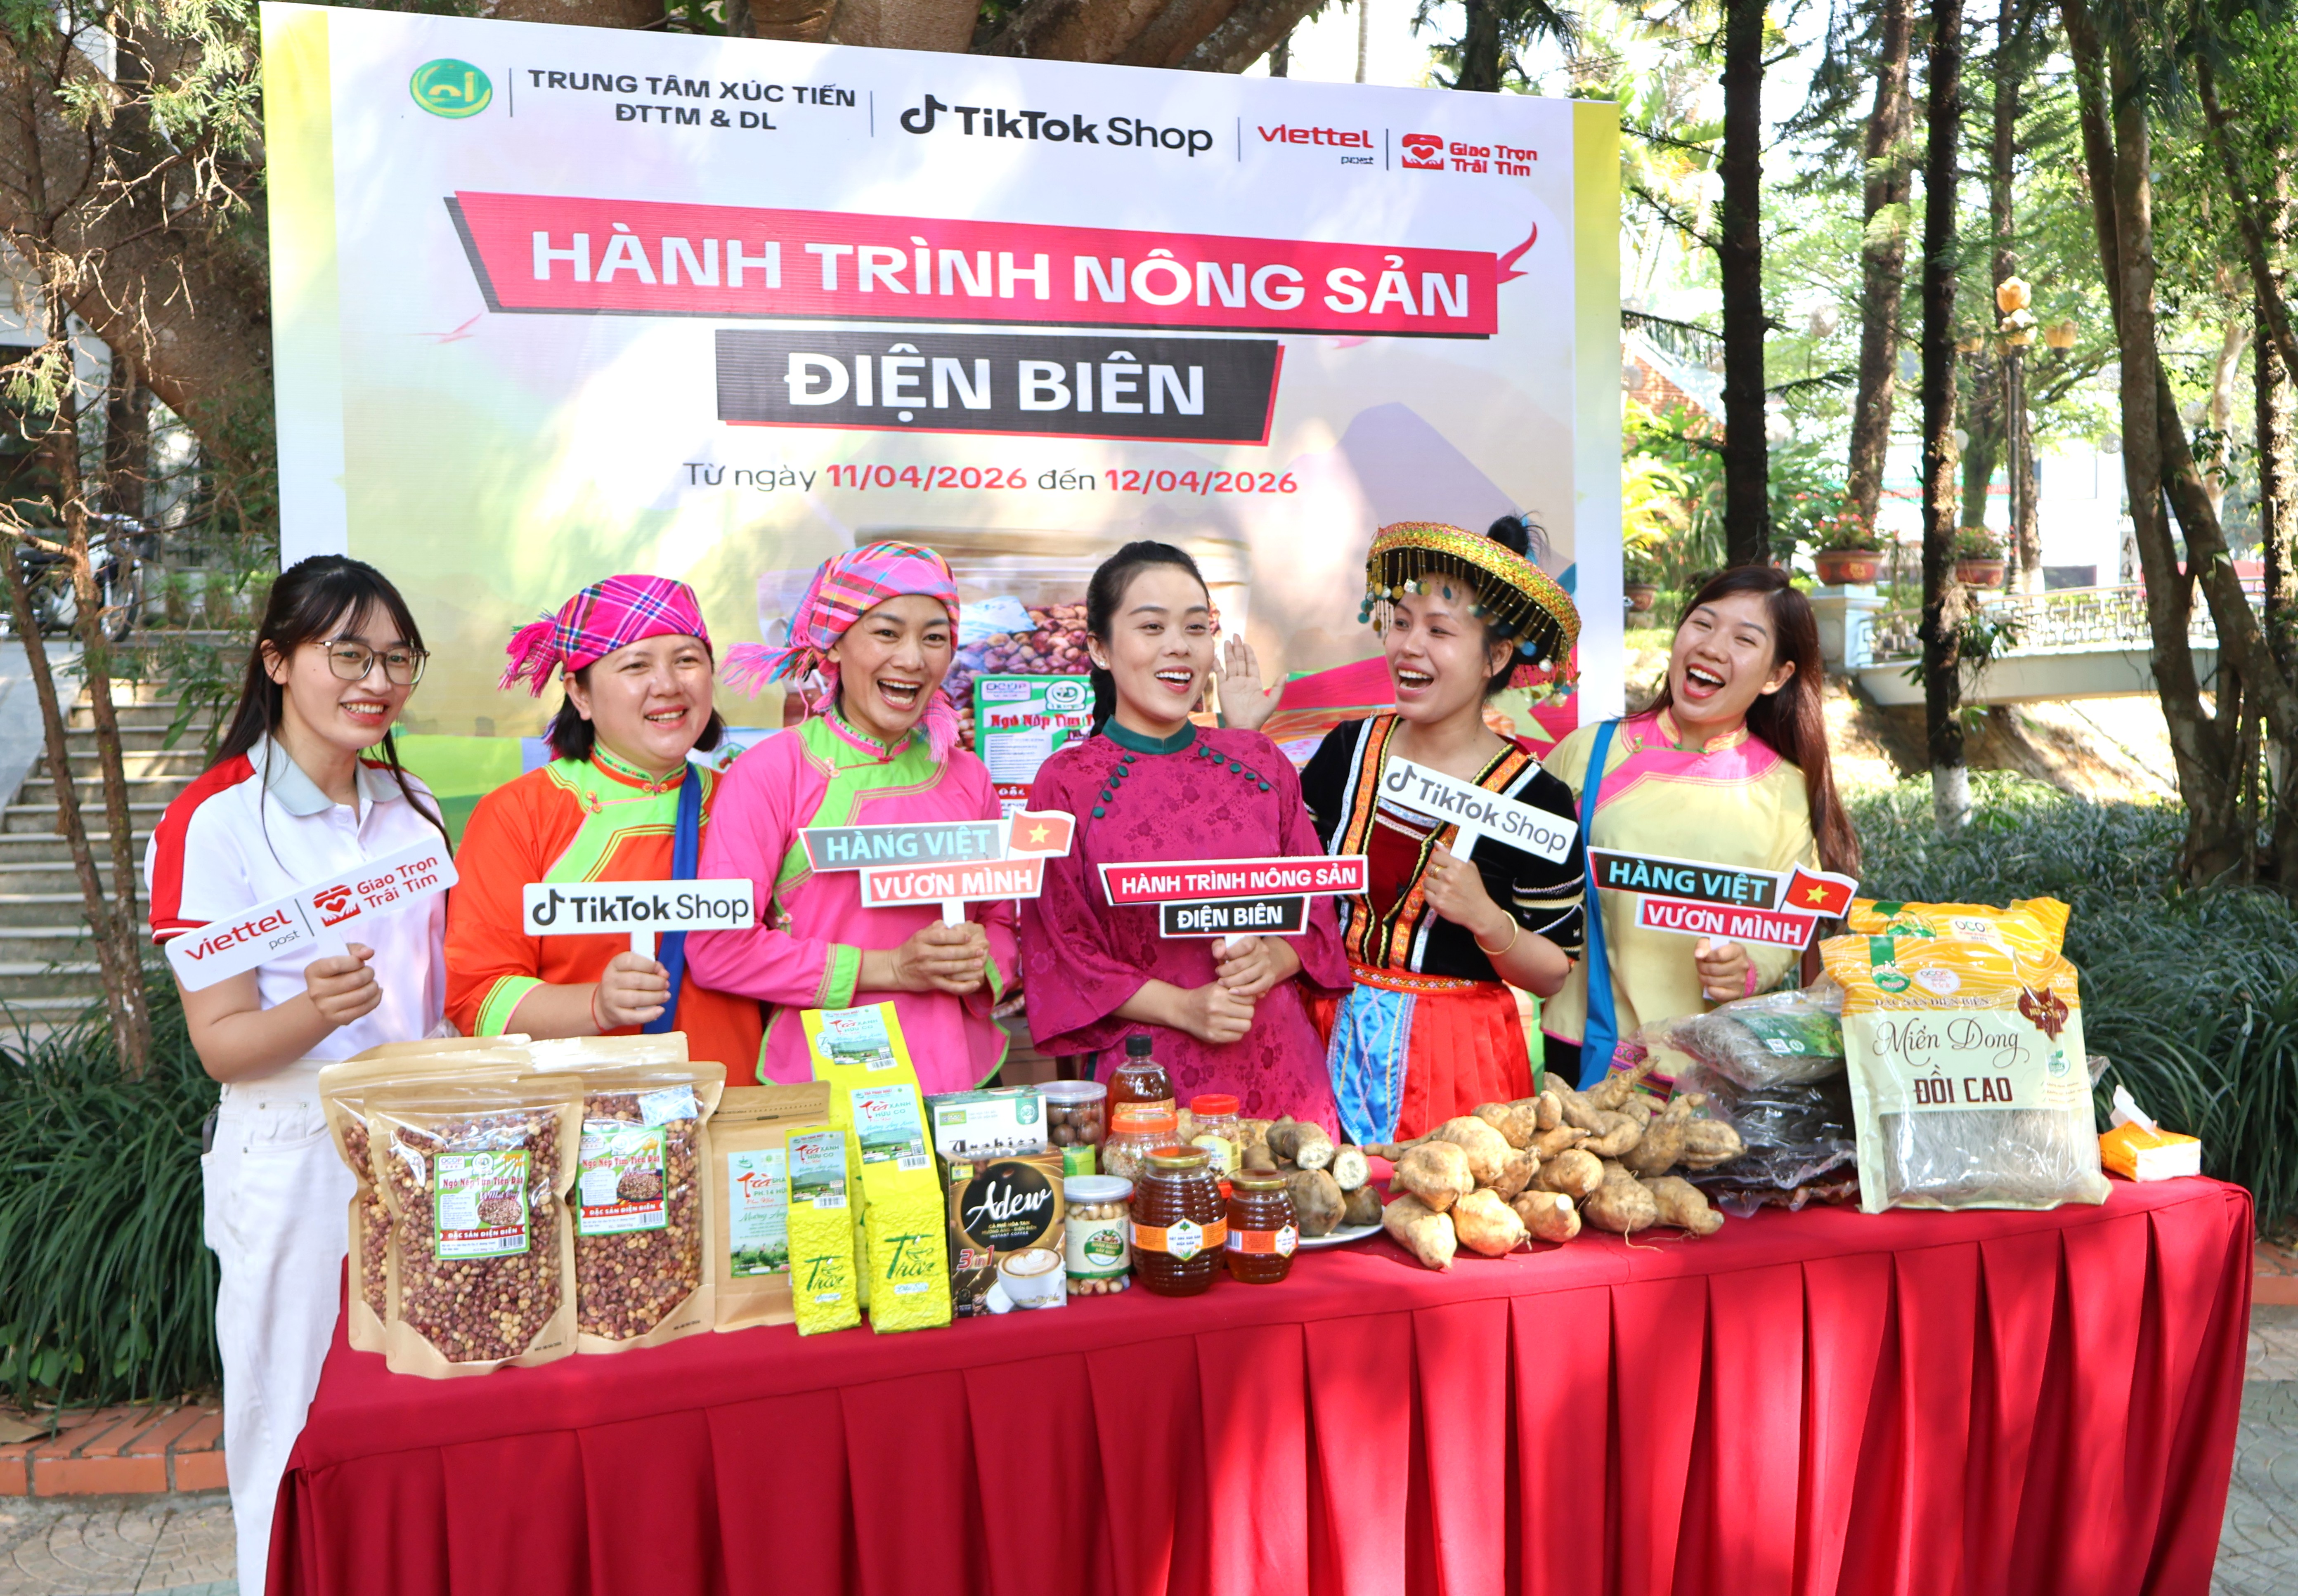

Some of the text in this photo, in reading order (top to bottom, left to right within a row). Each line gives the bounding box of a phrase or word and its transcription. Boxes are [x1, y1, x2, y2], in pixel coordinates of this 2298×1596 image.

[529, 70, 856, 107] TRUNG TÂM XÚC TIẾN
[615, 103, 777, 130] ĐTTM & DL
[954, 106, 1213, 158] TikTok Shop
[1258, 124, 1374, 148] viettel
[1450, 142, 1537, 161] Giao Trọn
[1451, 158, 1530, 176] Trái Tim
[532, 222, 1468, 318] HÀNH TRÌNH NÔNG SẢN
[784, 343, 1204, 423] ĐIỆN BIÊN
[683, 463, 1298, 496] Từ ngày 11/04/2026 đến 12/04/2026
[1420, 778, 1566, 854] TikTok Shop
[827, 826, 991, 861] HÀNG VIỆT
[357, 857, 438, 894] Giao Trọn
[364, 873, 438, 909] Trái Tim
[874, 867, 1032, 899] VƯƠN MÌNH
[1122, 863, 1356, 894] HÀNH TRÌNH NÔNG SẢN
[1609, 859, 1768, 905] HÀNG VIỆT
[570, 894, 748, 924] TikTok Shop
[1177, 902, 1282, 932] ĐIỆN BIÊN
[1647, 903, 1802, 944] VƯƠN MÌNH
[1955, 920, 1993, 933] OCOP
[184, 909, 292, 960] viettel
[269, 930, 300, 950] post
[1947, 1016, 2030, 1069] Dong
[1913, 1064, 1955, 1104] ĐỒI
[1964, 1077, 2012, 1103] CAO
[736, 1171, 772, 1198] Trà
[963, 1181, 1052, 1233] Adew
